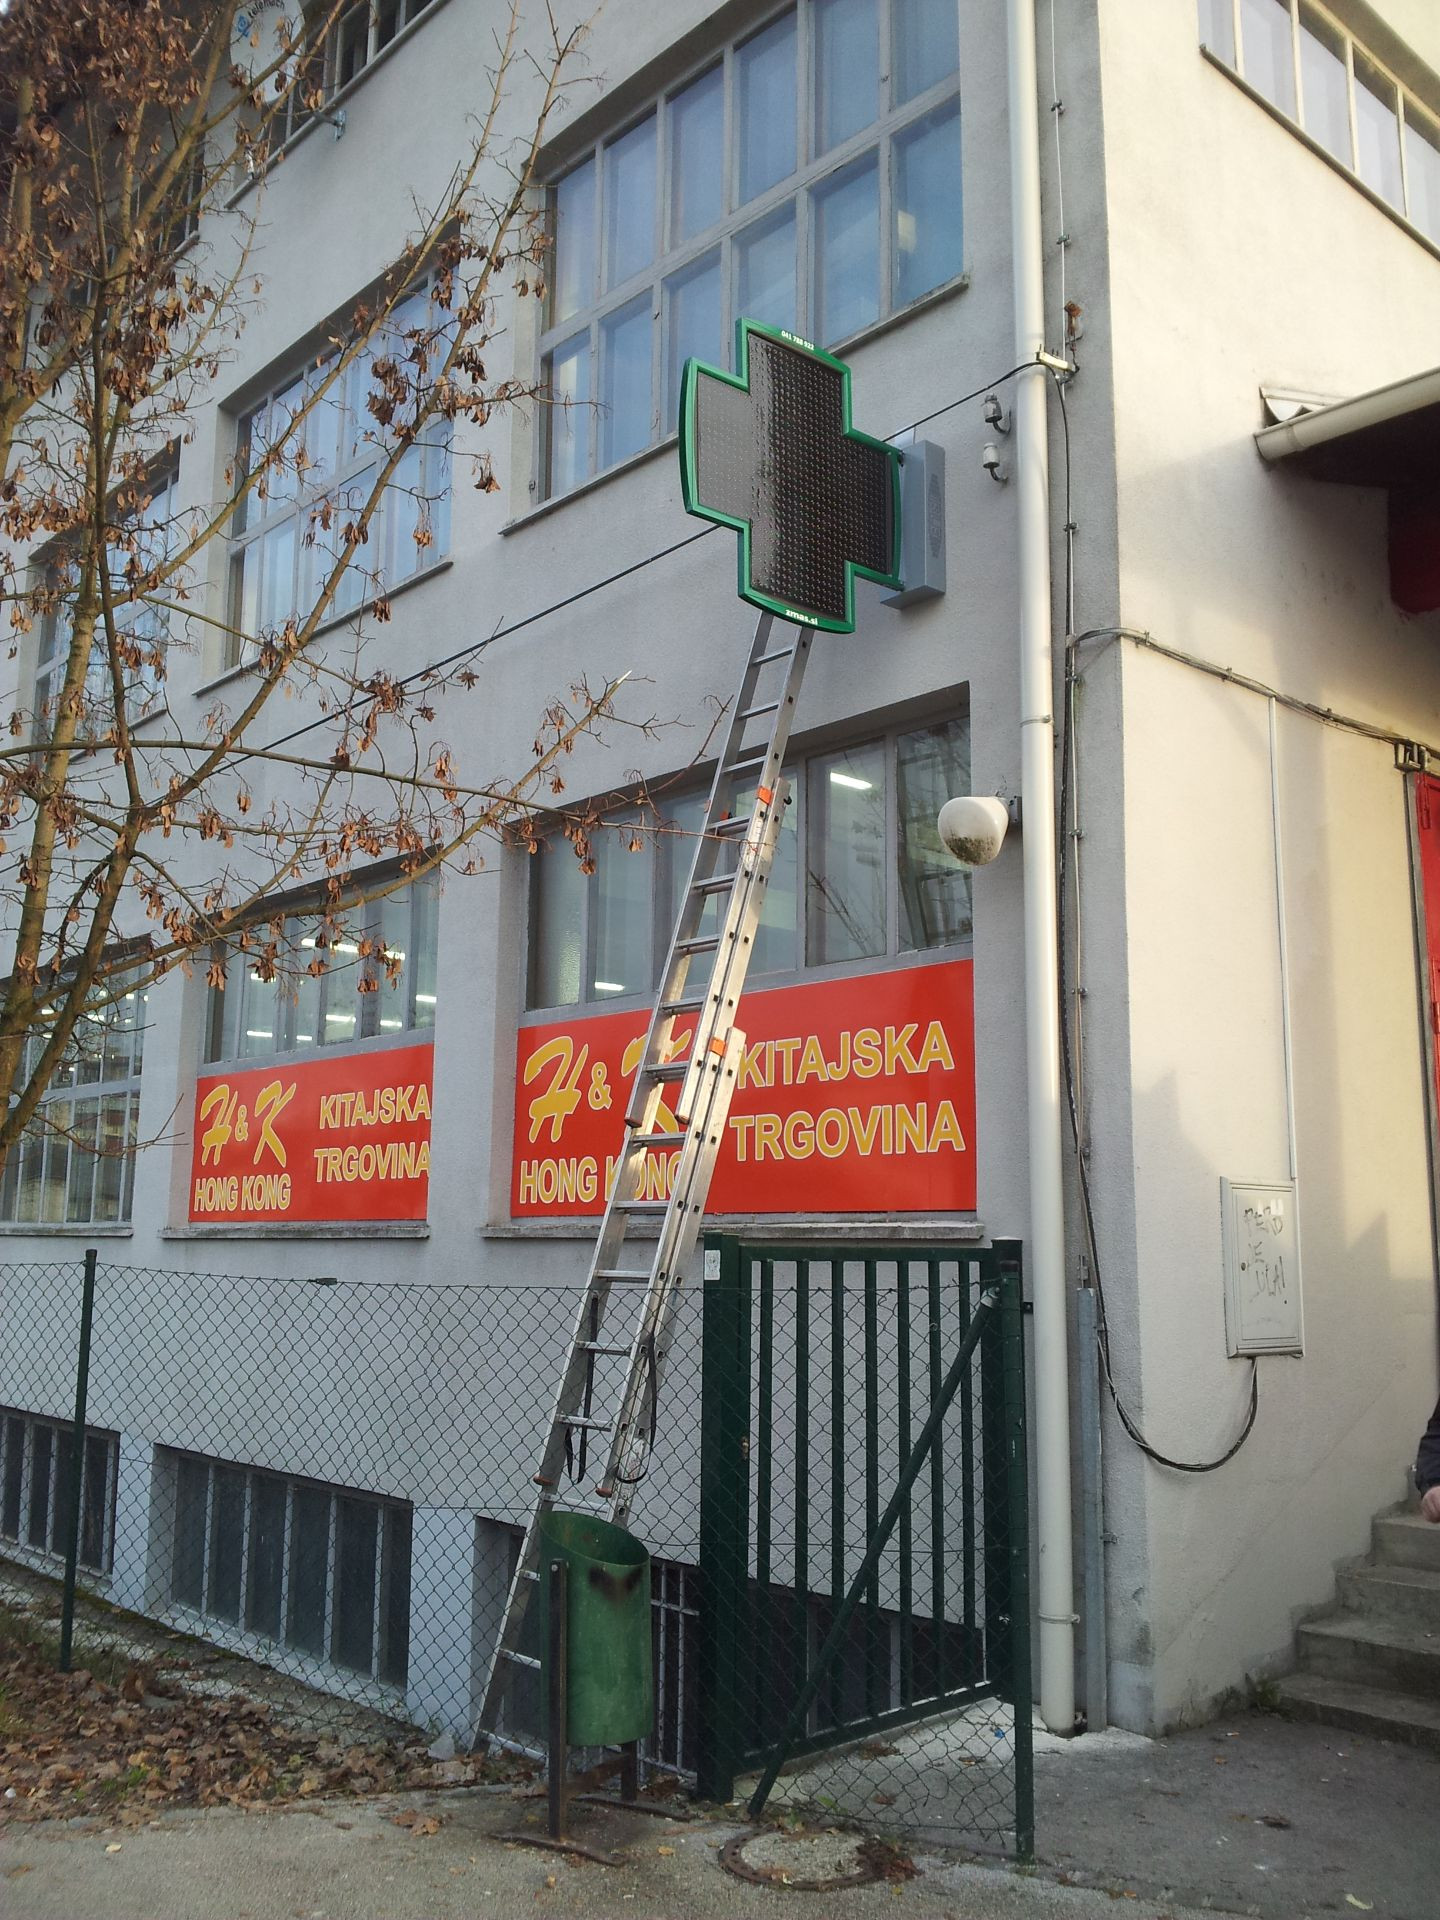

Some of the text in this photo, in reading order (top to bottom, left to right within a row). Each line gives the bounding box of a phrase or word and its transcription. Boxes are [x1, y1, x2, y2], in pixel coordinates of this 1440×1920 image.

[737, 1019, 956, 1090] KITAJSKA
[319, 1083, 432, 1130] KITAJSKA
[522, 1035, 589, 1144] H
[587, 1061, 613, 1111] &
[199, 1080, 297, 1169] H & K
[729, 1100, 966, 1162] TRGOVINA
[314, 1140, 430, 1183] TRGOVINA
[519, 1156, 598, 1205] HONG
[193, 1173, 292, 1212] HONG KONG
